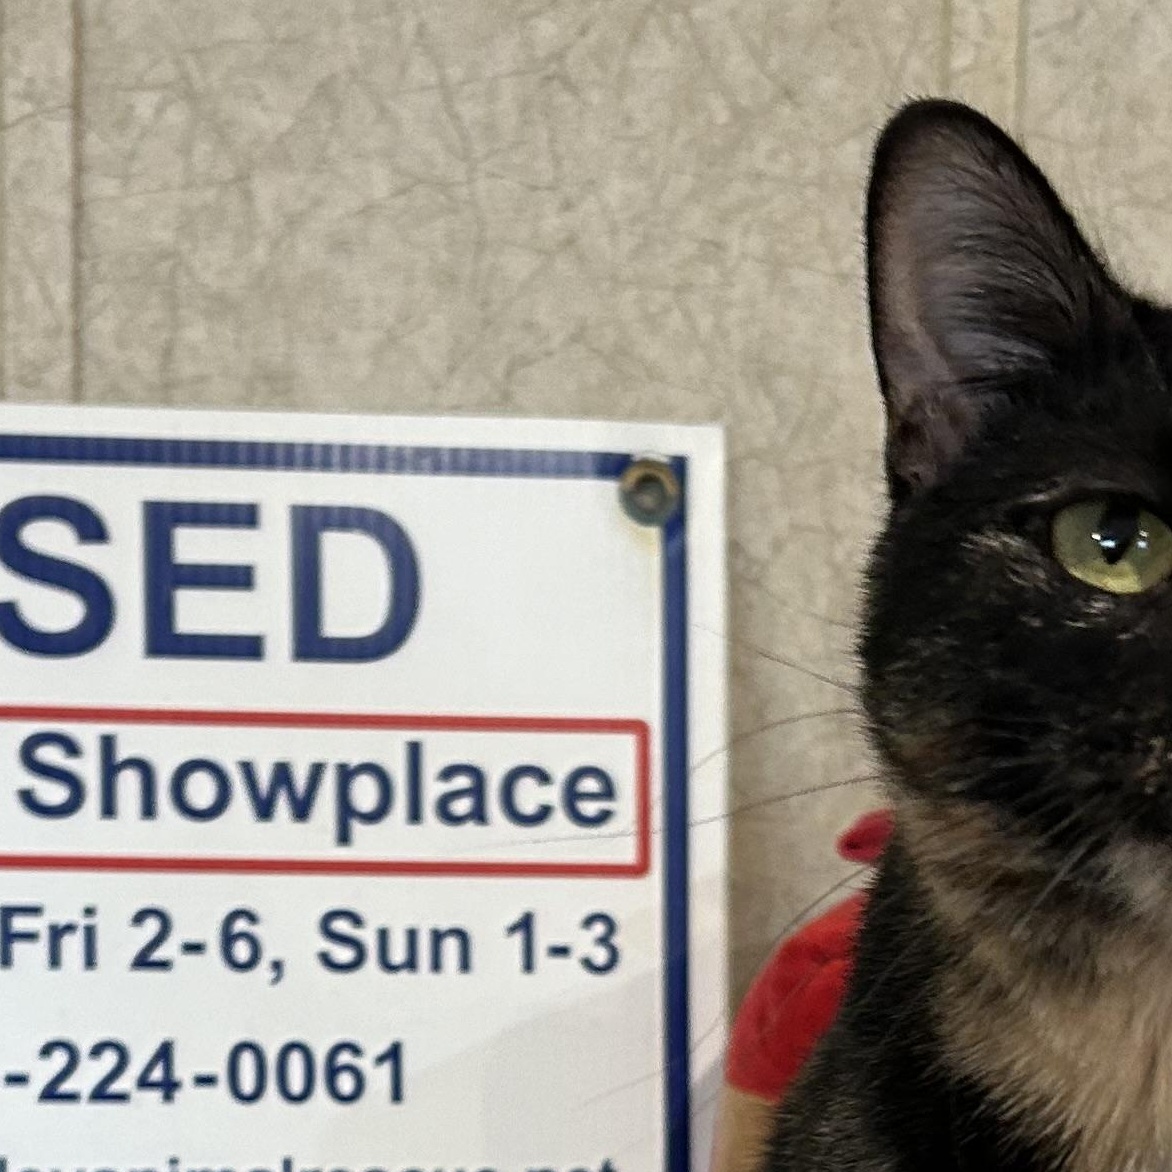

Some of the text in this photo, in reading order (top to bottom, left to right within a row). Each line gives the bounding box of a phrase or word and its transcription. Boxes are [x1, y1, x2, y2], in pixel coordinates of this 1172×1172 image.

[0, 494, 423, 664] SED
[17, 731, 617, 847] Showplace
[0, 905, 622, 985] Fri 2-6, Sun 1-3
[3, 1039, 406, 1105] -224-0061
